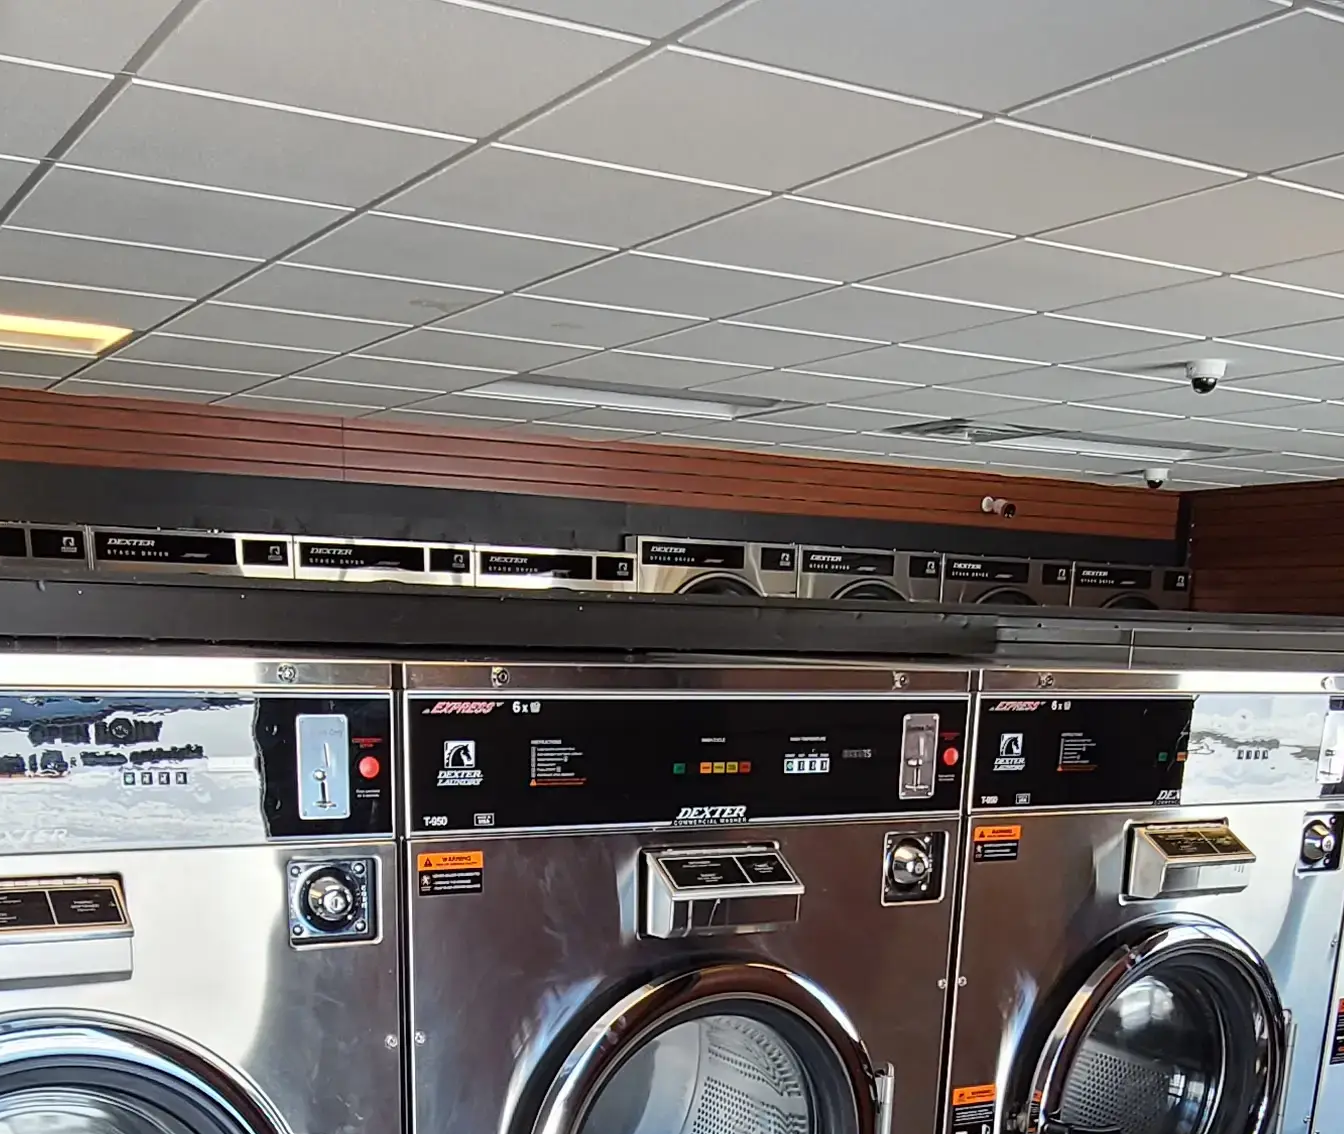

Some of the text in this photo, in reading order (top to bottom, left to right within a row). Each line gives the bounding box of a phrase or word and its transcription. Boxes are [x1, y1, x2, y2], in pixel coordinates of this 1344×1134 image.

[107, 538, 156, 547] DEXTER
[310, 547, 353, 556] DEXTER
[650, 546, 686, 554] DEXTER
[489, 556, 528, 564] DEXTER
[431, 700, 528, 714] EXPRESS 6 x
[437, 770, 482, 778] DEXTER
[1157, 790, 1181, 800] DEX
[676, 805, 747, 820] DEXTER
[423, 816, 448, 826] T-950
[673, 818, 718, 826] COMMERCIAL
